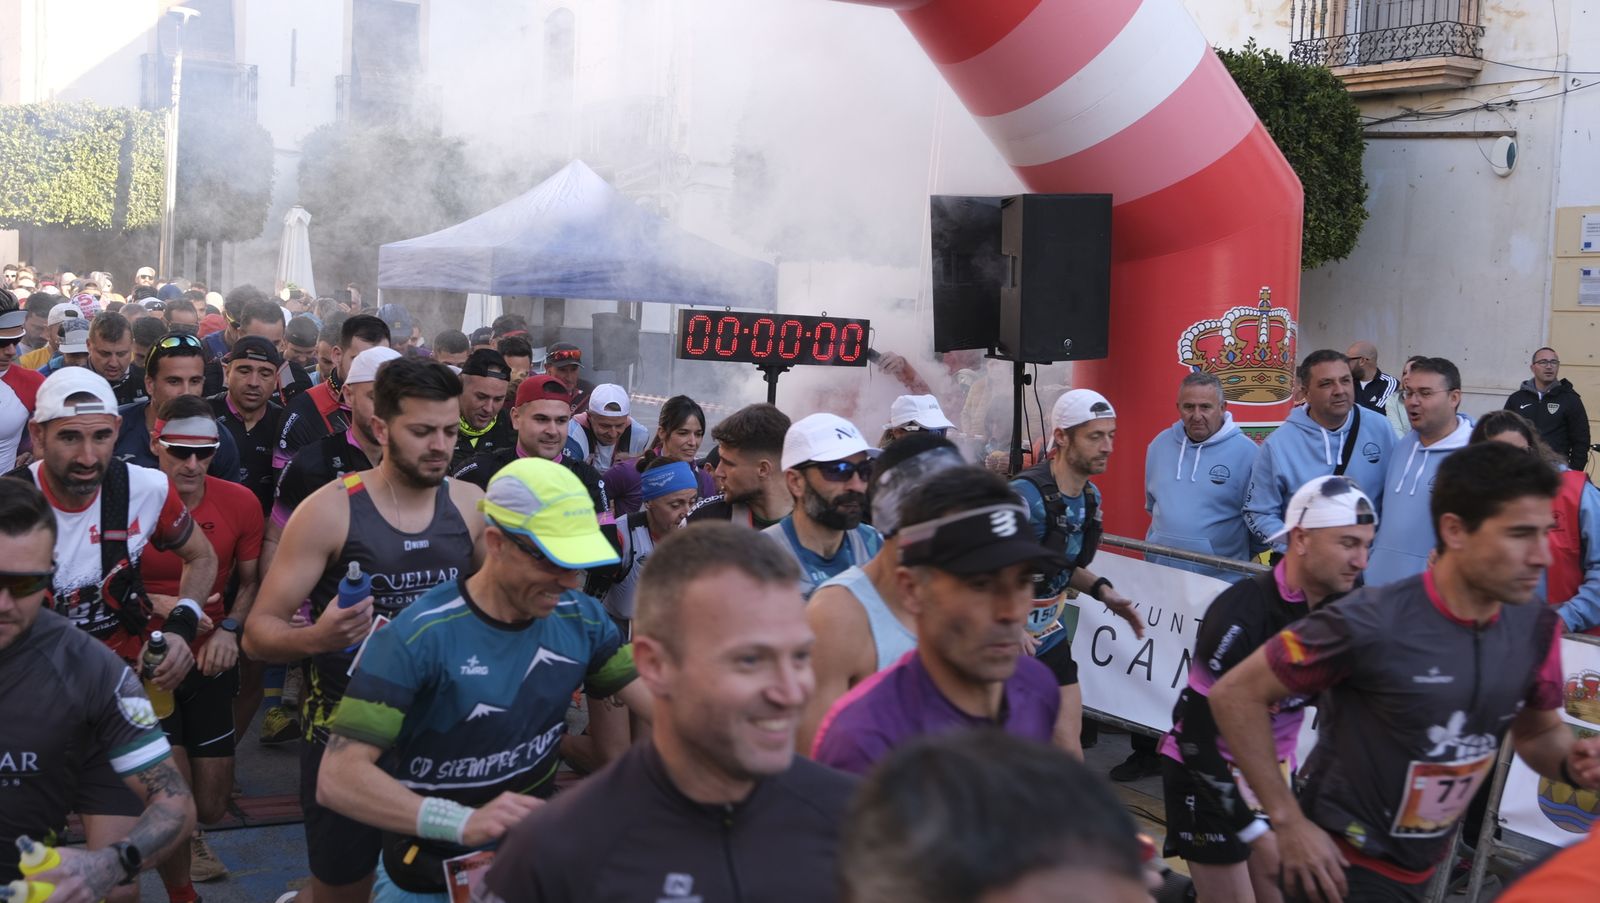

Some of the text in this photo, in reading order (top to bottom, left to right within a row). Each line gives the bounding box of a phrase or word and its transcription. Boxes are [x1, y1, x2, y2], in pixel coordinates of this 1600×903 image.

[686, 490, 726, 517] Espabr
[410, 756, 433, 778] CD
[436, 743, 527, 779] SIEMPRE
